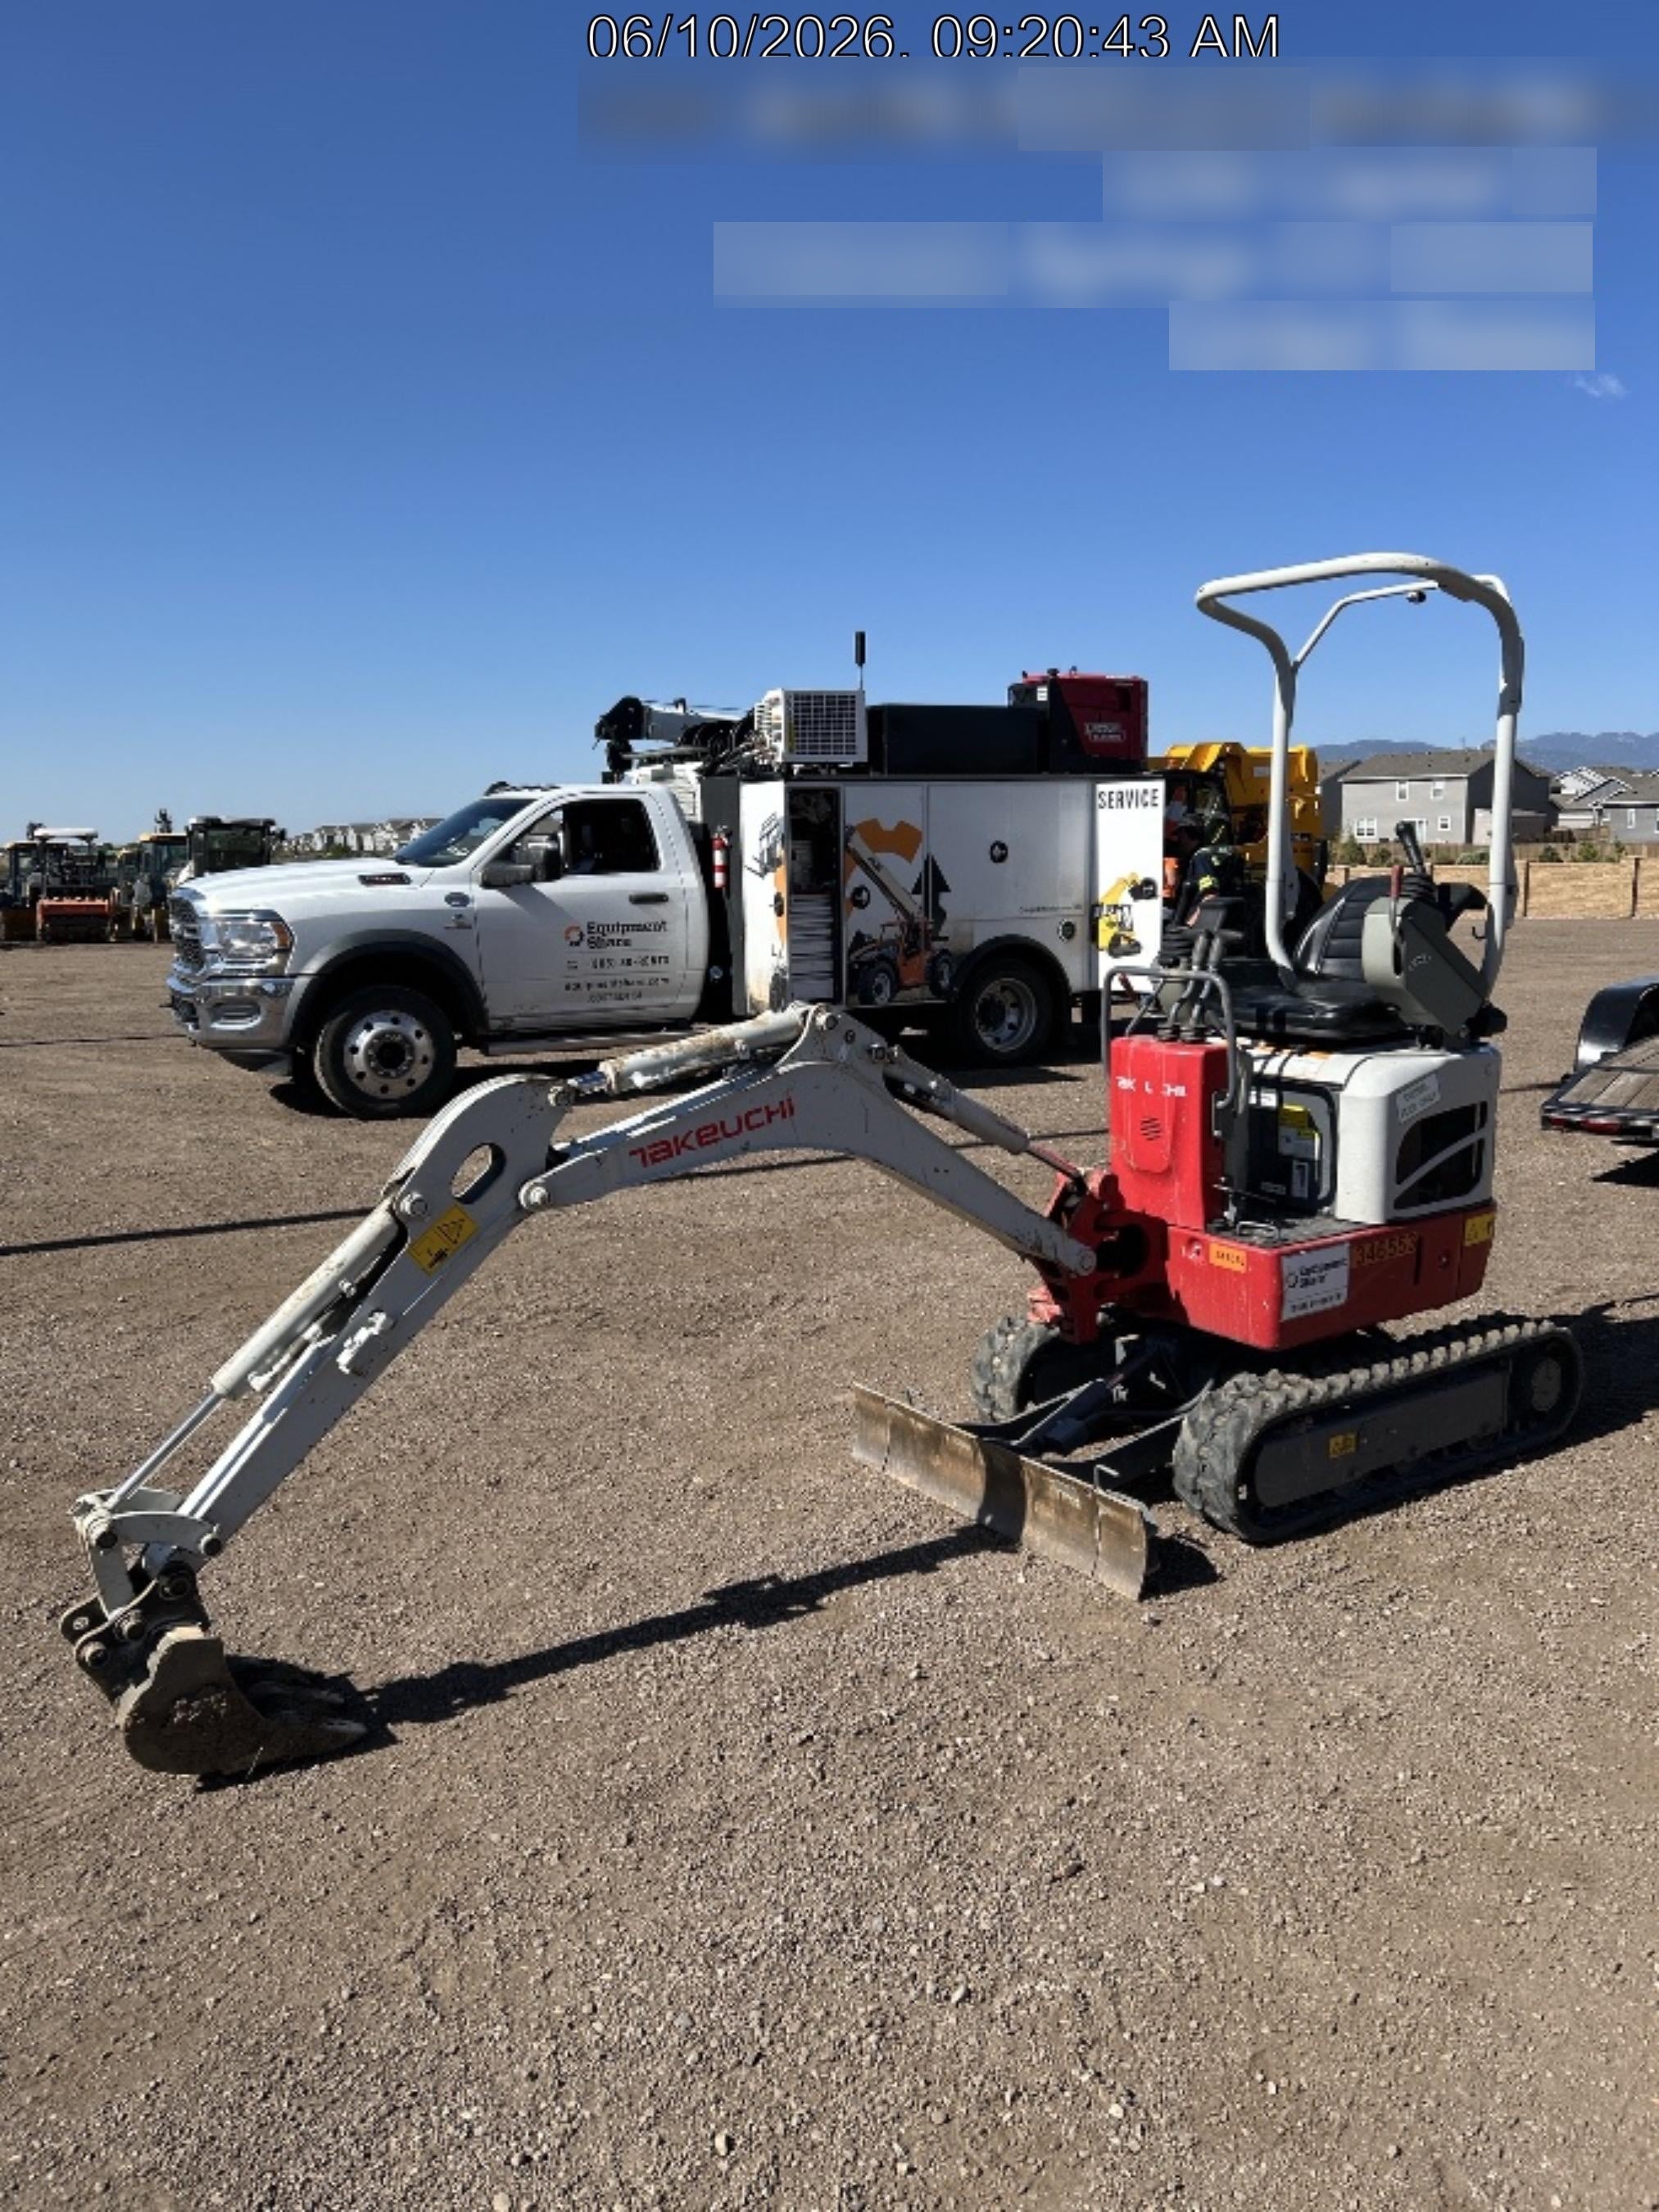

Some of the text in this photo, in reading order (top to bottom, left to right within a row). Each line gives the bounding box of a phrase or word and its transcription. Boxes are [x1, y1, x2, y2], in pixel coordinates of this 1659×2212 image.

[1098, 788, 1158, 809] SERVICE
[587, 920, 668, 936] Equipment
[587, 936, 632, 950] Share
